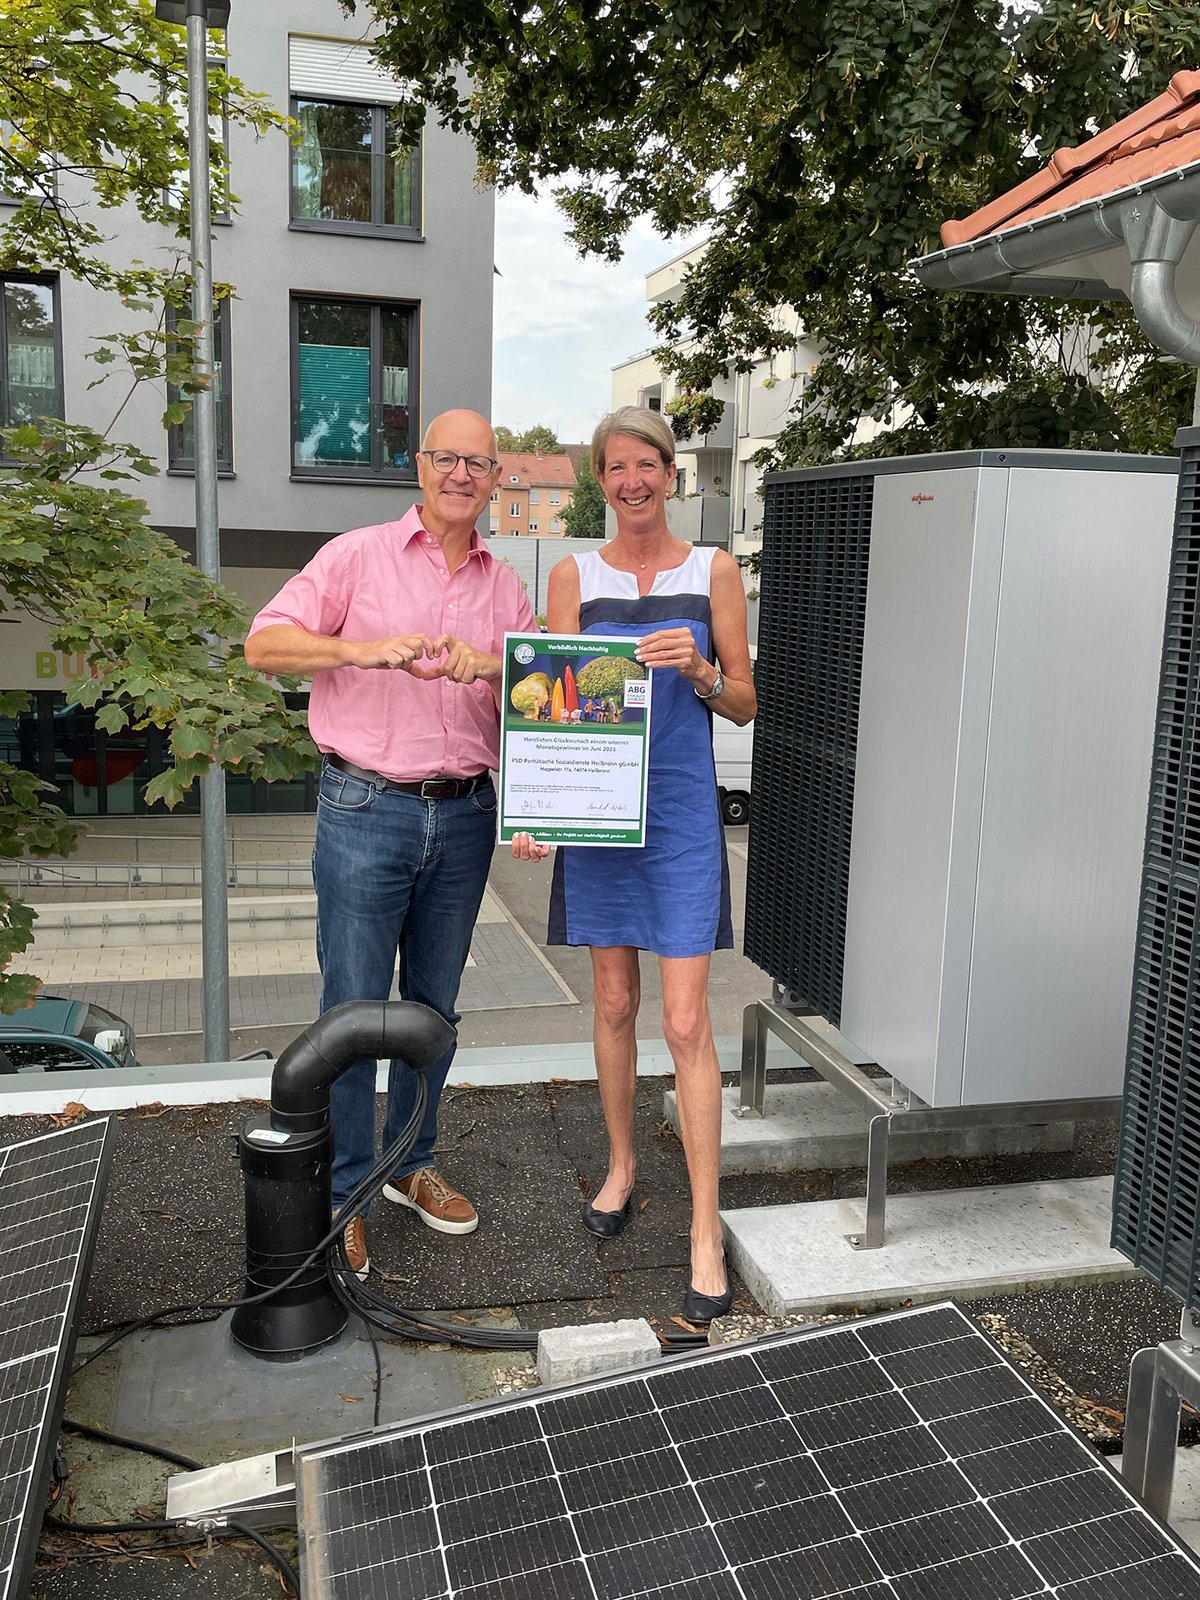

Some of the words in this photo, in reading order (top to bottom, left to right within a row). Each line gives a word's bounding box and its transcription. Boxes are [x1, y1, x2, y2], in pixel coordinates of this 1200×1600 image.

[547, 643, 578, 651] Vorbildlich
[578, 645, 609, 653] Nachhaltig
[627, 685, 646, 694] ABG
